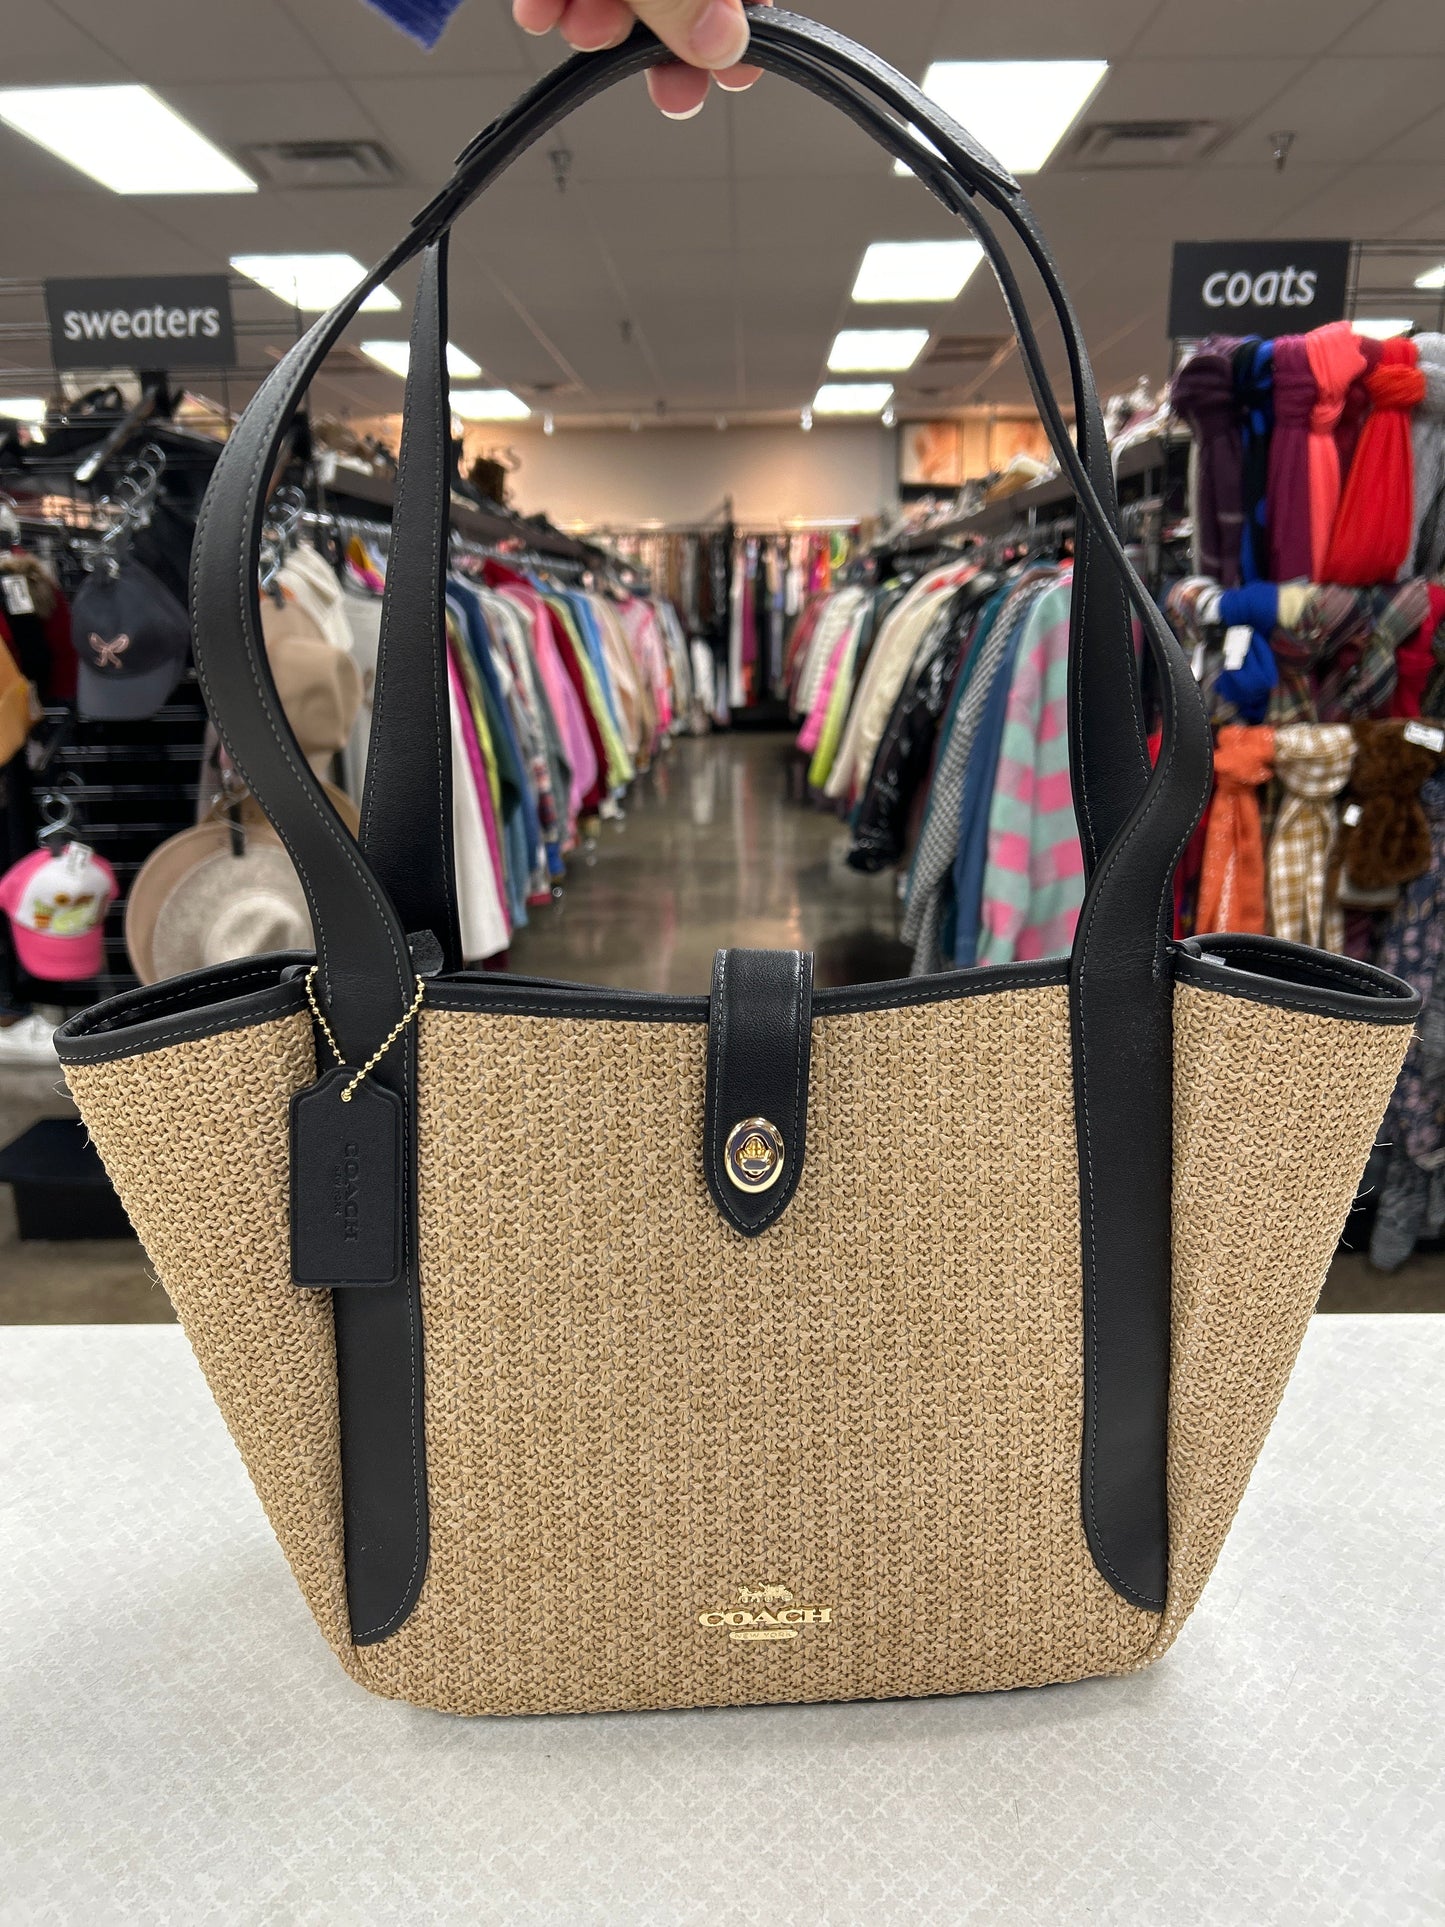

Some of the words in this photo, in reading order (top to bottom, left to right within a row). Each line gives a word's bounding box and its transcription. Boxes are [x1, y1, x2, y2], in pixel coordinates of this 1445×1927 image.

[1202, 265, 1318, 307] coats
[63, 304, 221, 341] sweaters
[344, 1142, 360, 1242] COACH
[698, 1607, 833, 1627] COACH
[734, 1632, 760, 1640] NEW
[763, 1631, 792, 1639] YORK
